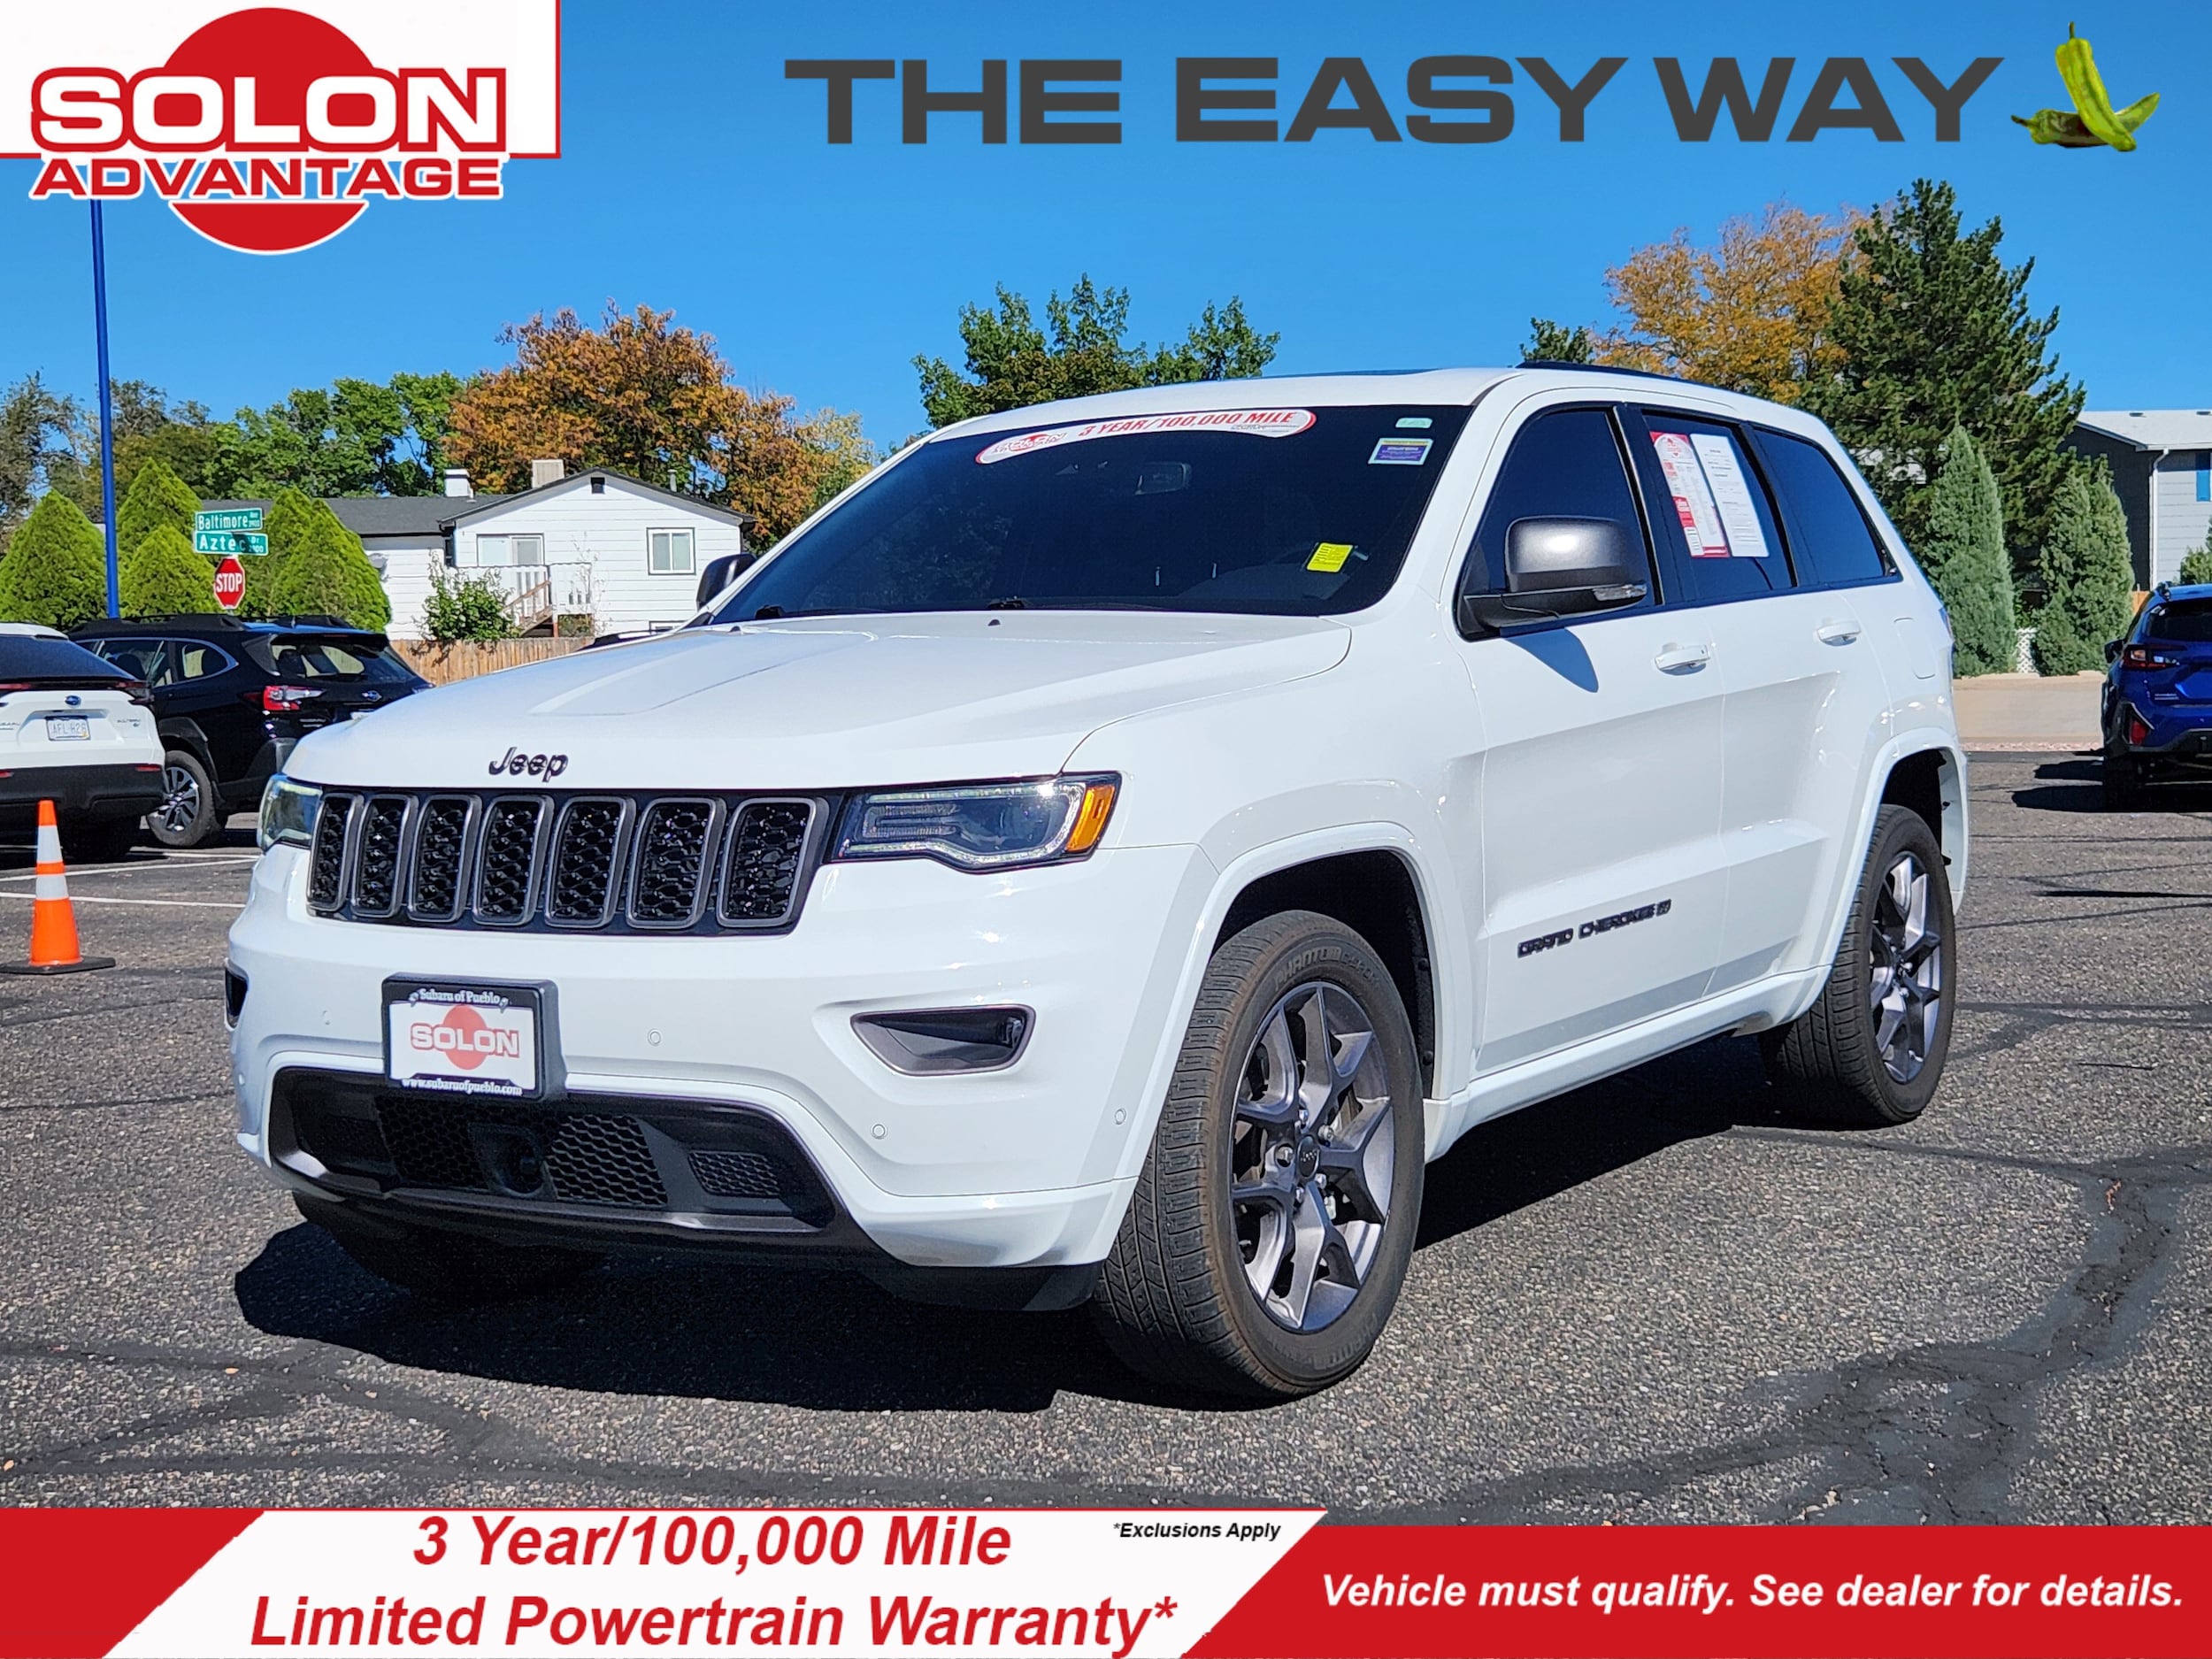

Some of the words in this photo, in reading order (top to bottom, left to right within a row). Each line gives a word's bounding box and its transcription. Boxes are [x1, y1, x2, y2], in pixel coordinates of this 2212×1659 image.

[1078, 425, 1096, 436] 3
[1097, 412, 1243, 434] YEAR/100,000
[1243, 411, 1298, 423] MILE
[197, 514, 249, 531] Baltimore
[199, 534, 245, 550] Aztec
[215, 572, 242, 593] STOP
[488, 746, 569, 783] Jeep
[1517, 928, 1574, 958] GRAND
[1578, 903, 1655, 940] CHEROKEE
[417, 987, 454, 1002] Subaru
[454, 990, 466, 1002] of
[466, 990, 501, 1004] Pueblo
[411, 1023, 519, 1058] SOLON
[401, 1077, 523, 1097] www.subaruofpueblo.com
